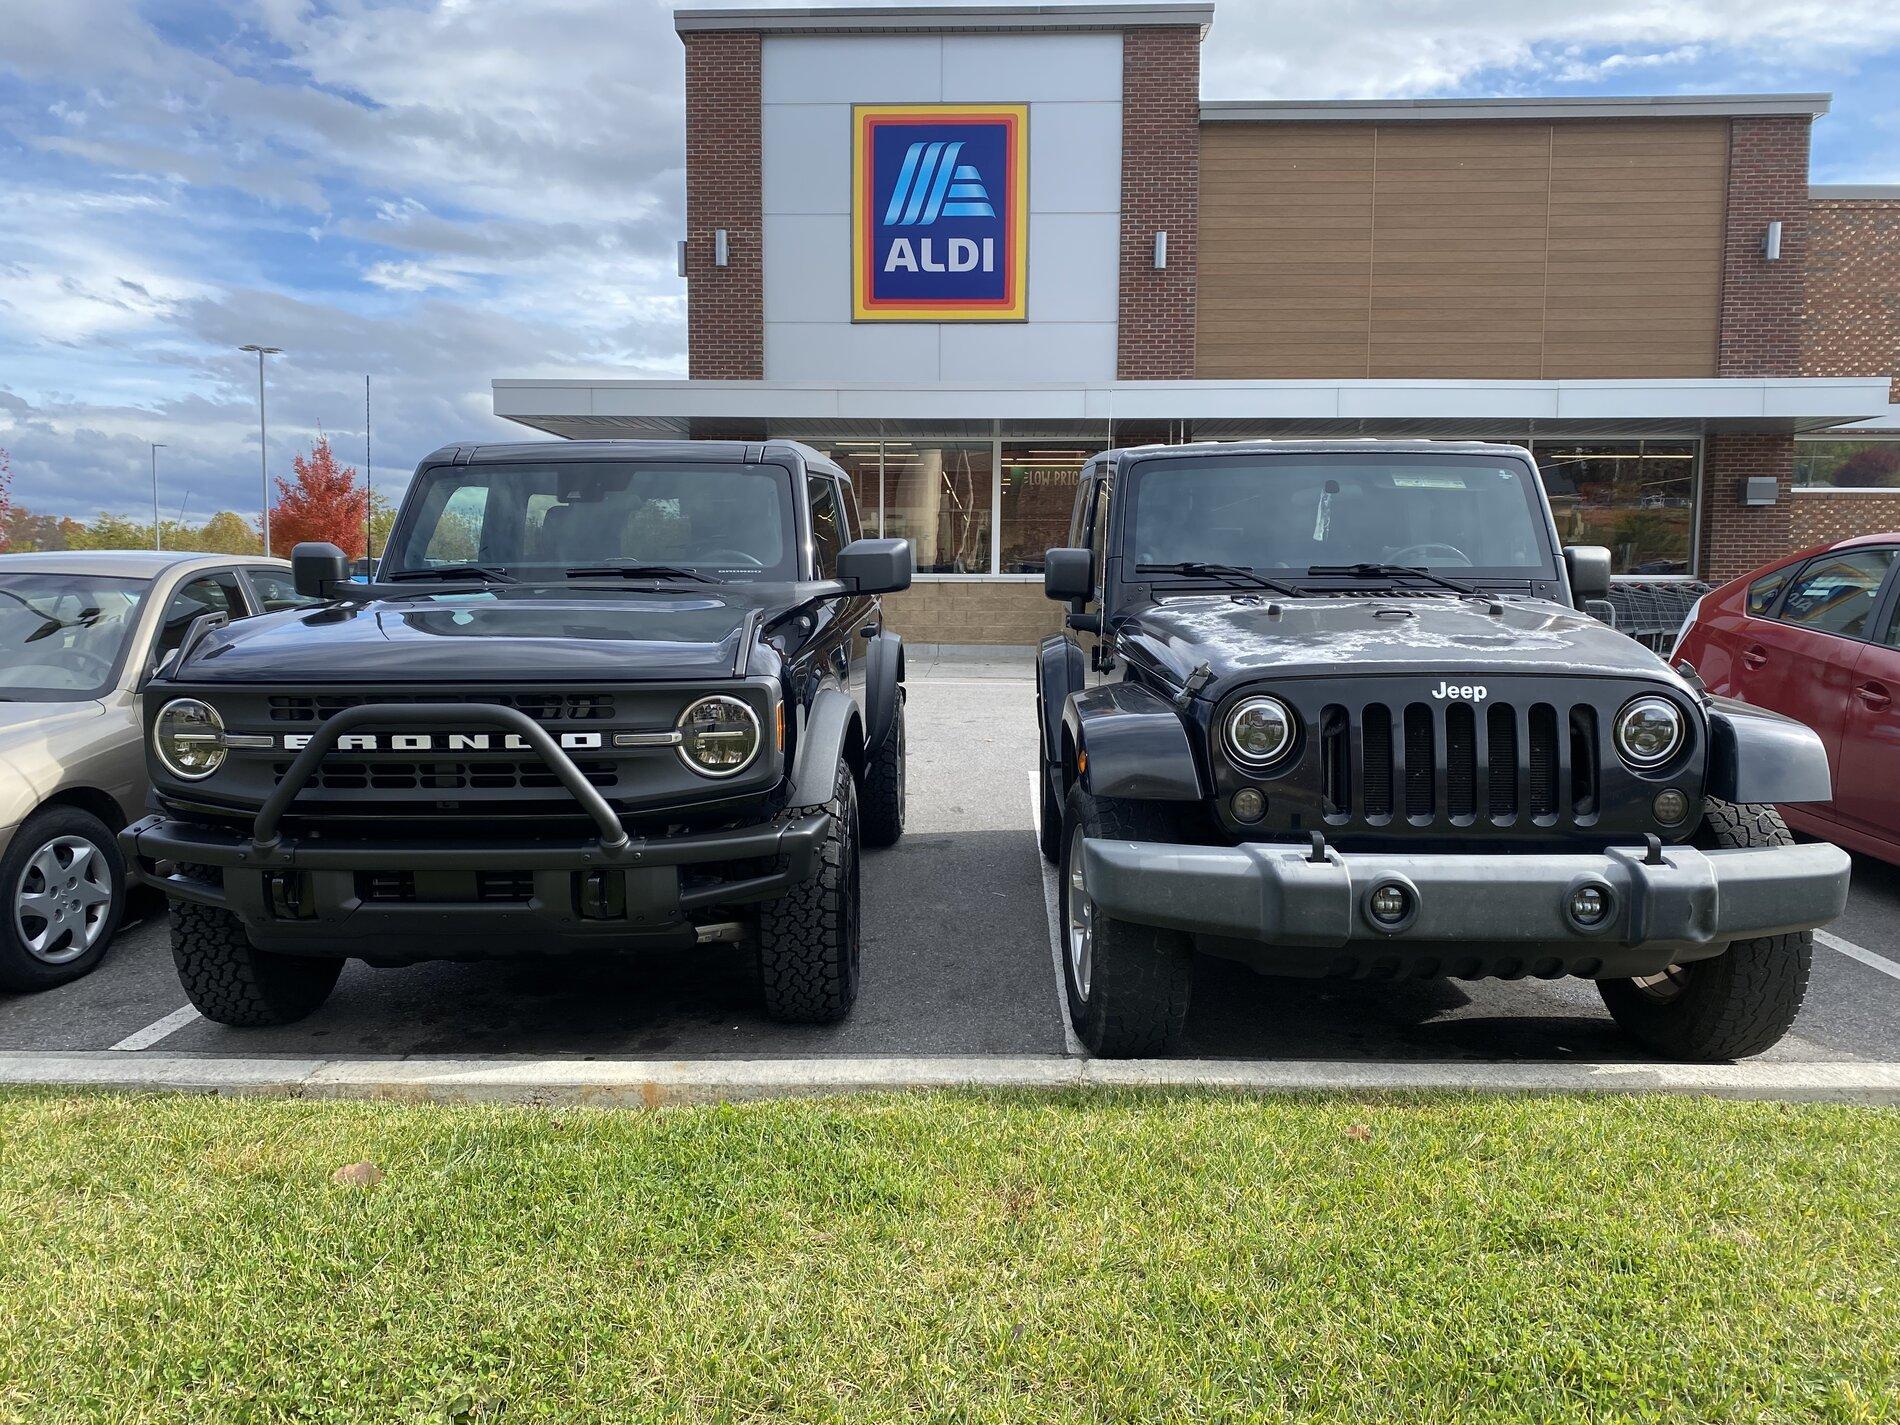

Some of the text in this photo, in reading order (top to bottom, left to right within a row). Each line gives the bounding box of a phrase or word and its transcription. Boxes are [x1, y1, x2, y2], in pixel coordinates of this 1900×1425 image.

[883, 237, 994, 273] ALDI
[1029, 470, 1079, 486] LOW PRIC
[1431, 681, 1488, 703] Jeep
